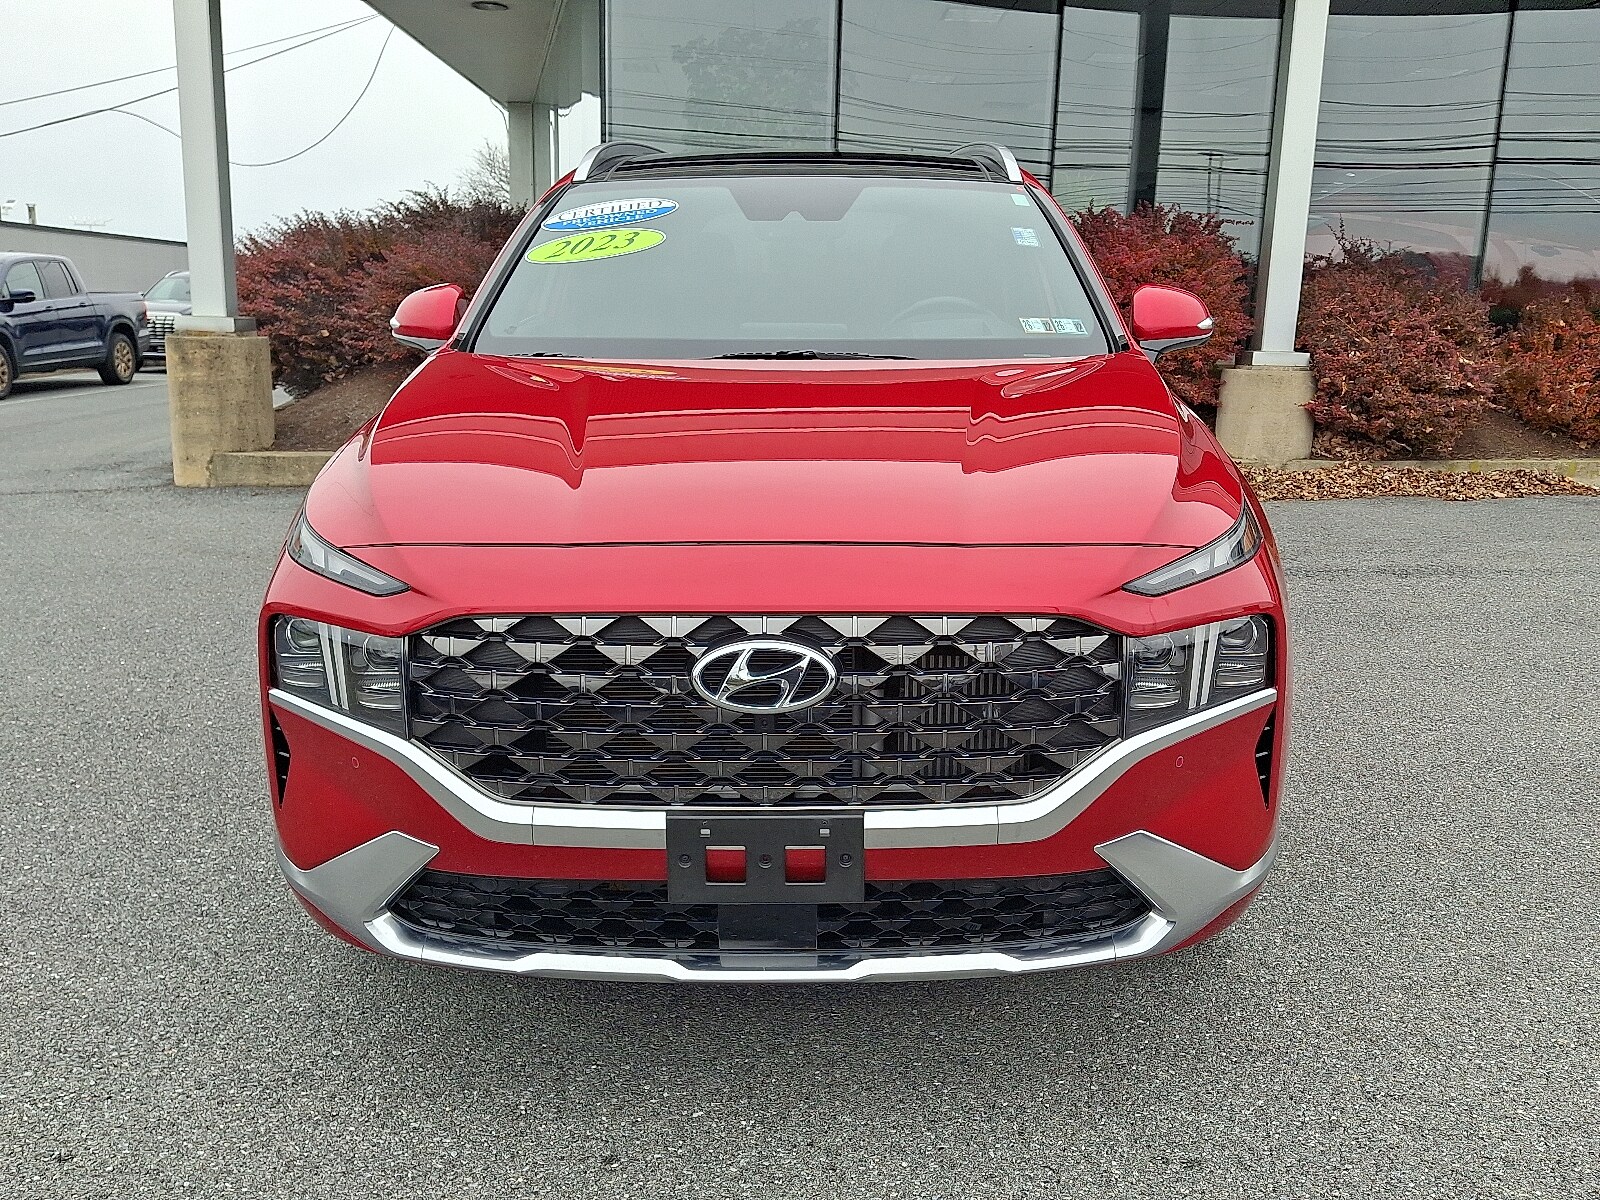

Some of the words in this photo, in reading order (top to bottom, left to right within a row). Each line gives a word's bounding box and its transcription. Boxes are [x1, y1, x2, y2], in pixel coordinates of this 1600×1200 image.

[559, 200, 662, 220] CERTIFIED
[562, 208, 658, 226] PRE-OWNED
[579, 214, 645, 228] VEHICLE
[544, 231, 640, 259] 2023
